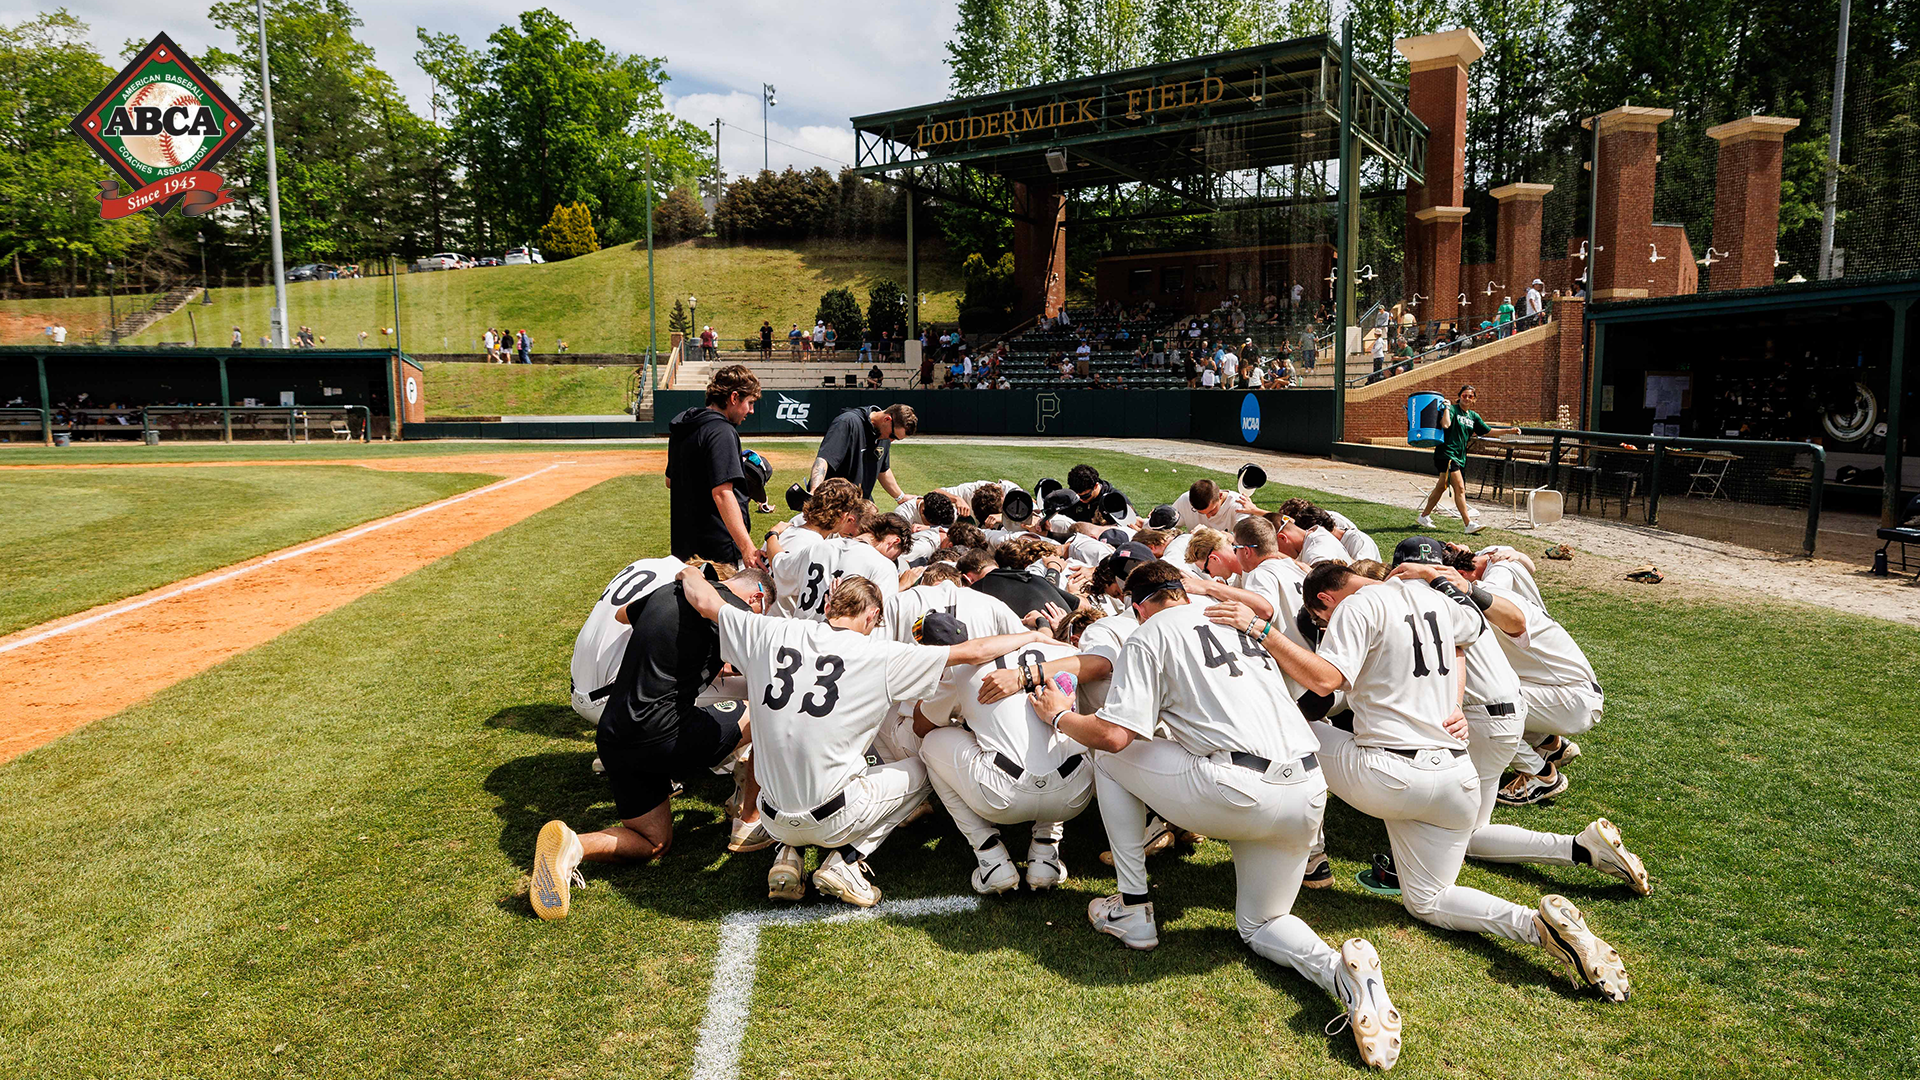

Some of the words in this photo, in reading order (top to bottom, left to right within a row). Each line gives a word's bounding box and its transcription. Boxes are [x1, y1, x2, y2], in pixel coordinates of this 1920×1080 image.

[917, 97, 1099, 147] LOUDERMILK
[1126, 76, 1225, 117] FIELD
[776, 403, 811, 419] CCS
[1036, 392, 1060, 432] P
[1242, 417, 1260, 430] NCAA
[1419, 544, 1432, 560] P
[1193, 624, 1273, 677] 44
[1404, 610, 1450, 678] 11
[762, 645, 847, 718] 33
